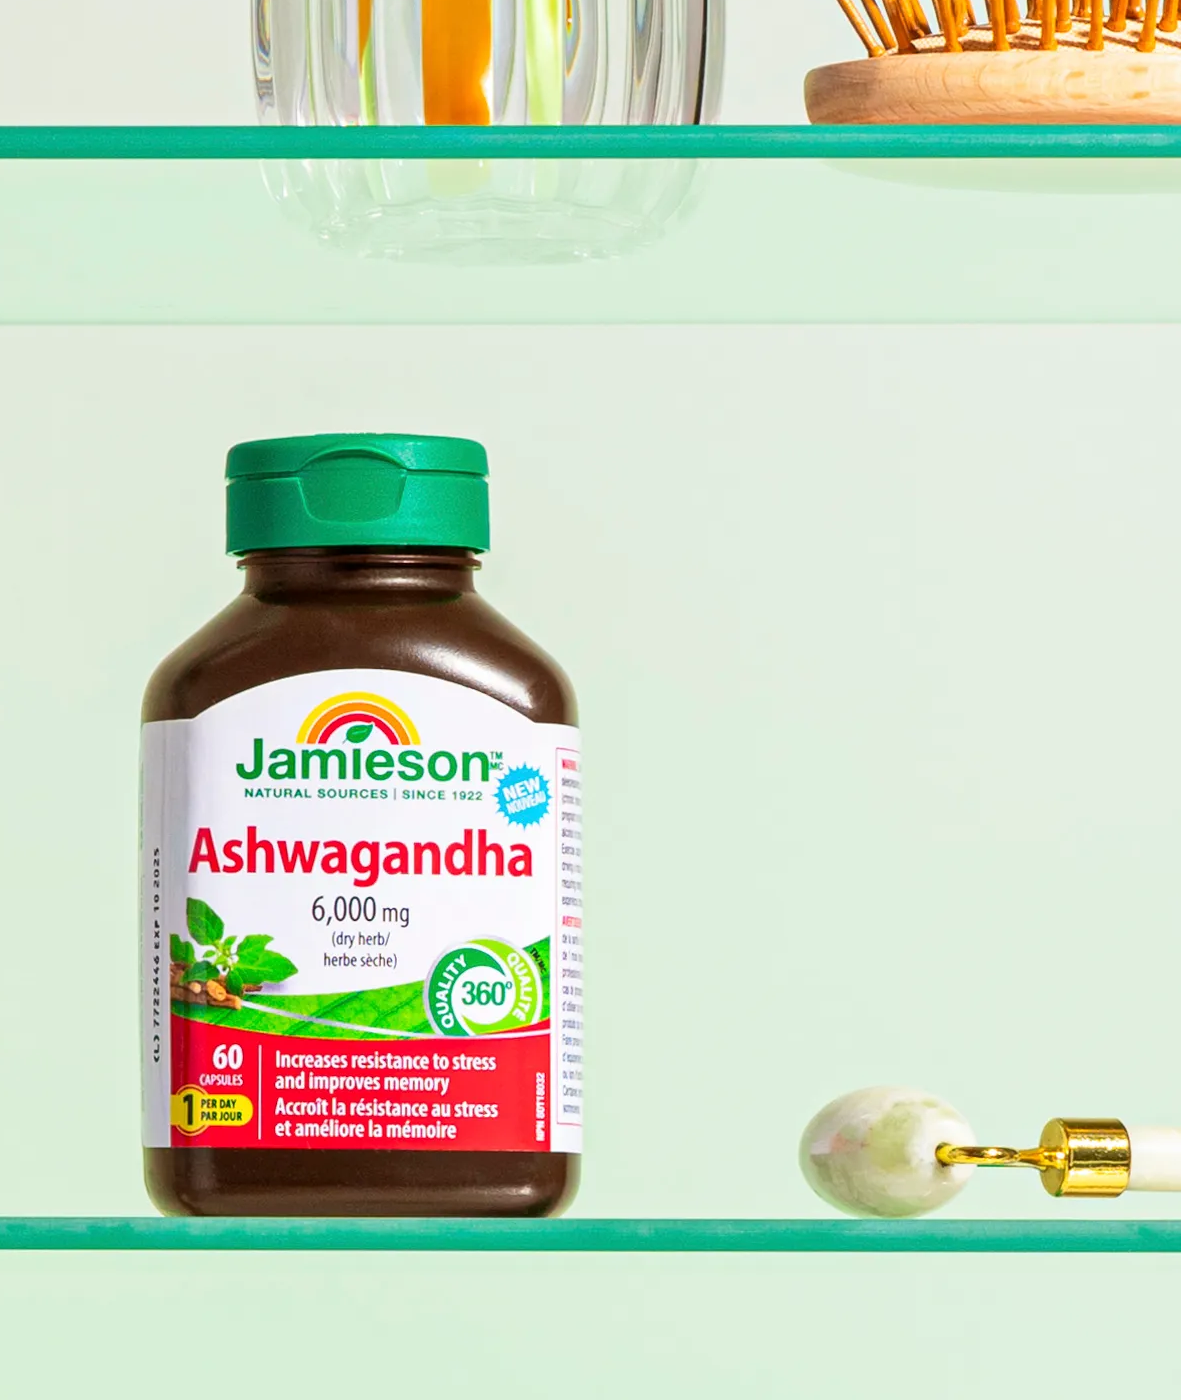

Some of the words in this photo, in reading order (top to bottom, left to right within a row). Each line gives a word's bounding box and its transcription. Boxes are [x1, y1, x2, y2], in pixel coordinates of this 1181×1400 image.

[236, 737, 489, 782] Jamieson
[244, 788, 312, 799] NATURAL
[317, 788, 388, 800] SOURCES
[402, 789, 447, 800] SINCE
[452, 789, 483, 801] 1922
[503, 775, 543, 799] NEW
[506, 790, 548, 815] NOUVEAU
[188, 825, 533, 887] Ashwagandha
[152, 848, 160, 889] 2025
[152, 894, 160, 913] 10
[311, 895, 377, 927] 6,000
[382, 905, 410, 927] mg
[152, 920, 160, 950] EXP
[331, 931, 355, 949] (dry
[358, 931, 390, 948] herb/
[323, 952, 358, 968] herbe
[361, 952, 398, 970] sèche)
[431, 953, 469, 1028] QUALITY
[461, 979, 514, 1007] 360°
[506, 951, 540, 1019] QUALITÉ
[212, 1043, 244, 1071] 60
[275, 1050, 348, 1070] Increases
[351, 1050, 430, 1071] resistance
[433, 1052, 449, 1071] to
[453, 1053, 497, 1072] stress
[199, 1072, 244, 1087] CAPSULES
[275, 1071, 305, 1091] and
[309, 1072, 381, 1096] improves
[384, 1075, 450, 1097] memory
[182, 1094, 196, 1127] 1
[200, 1098, 216, 1109] PER
[218, 1098, 237, 1110] DAY
[200, 1110, 218, 1122] PAR
[219, 1110, 243, 1123] JOUR
[275, 1097, 328, 1117] Accroît
[332, 1097, 346, 1117] la
[350, 1097, 428, 1118] résistance
[432, 1102, 451, 1118] au
[454, 1100, 499, 1119] stress
[275, 1120, 291, 1138] et
[295, 1117, 365, 1138] améliore
[369, 1119, 383, 1139] la
[386, 1119, 457, 1139] mémoire
[536, 1121, 545, 1141] NPN
